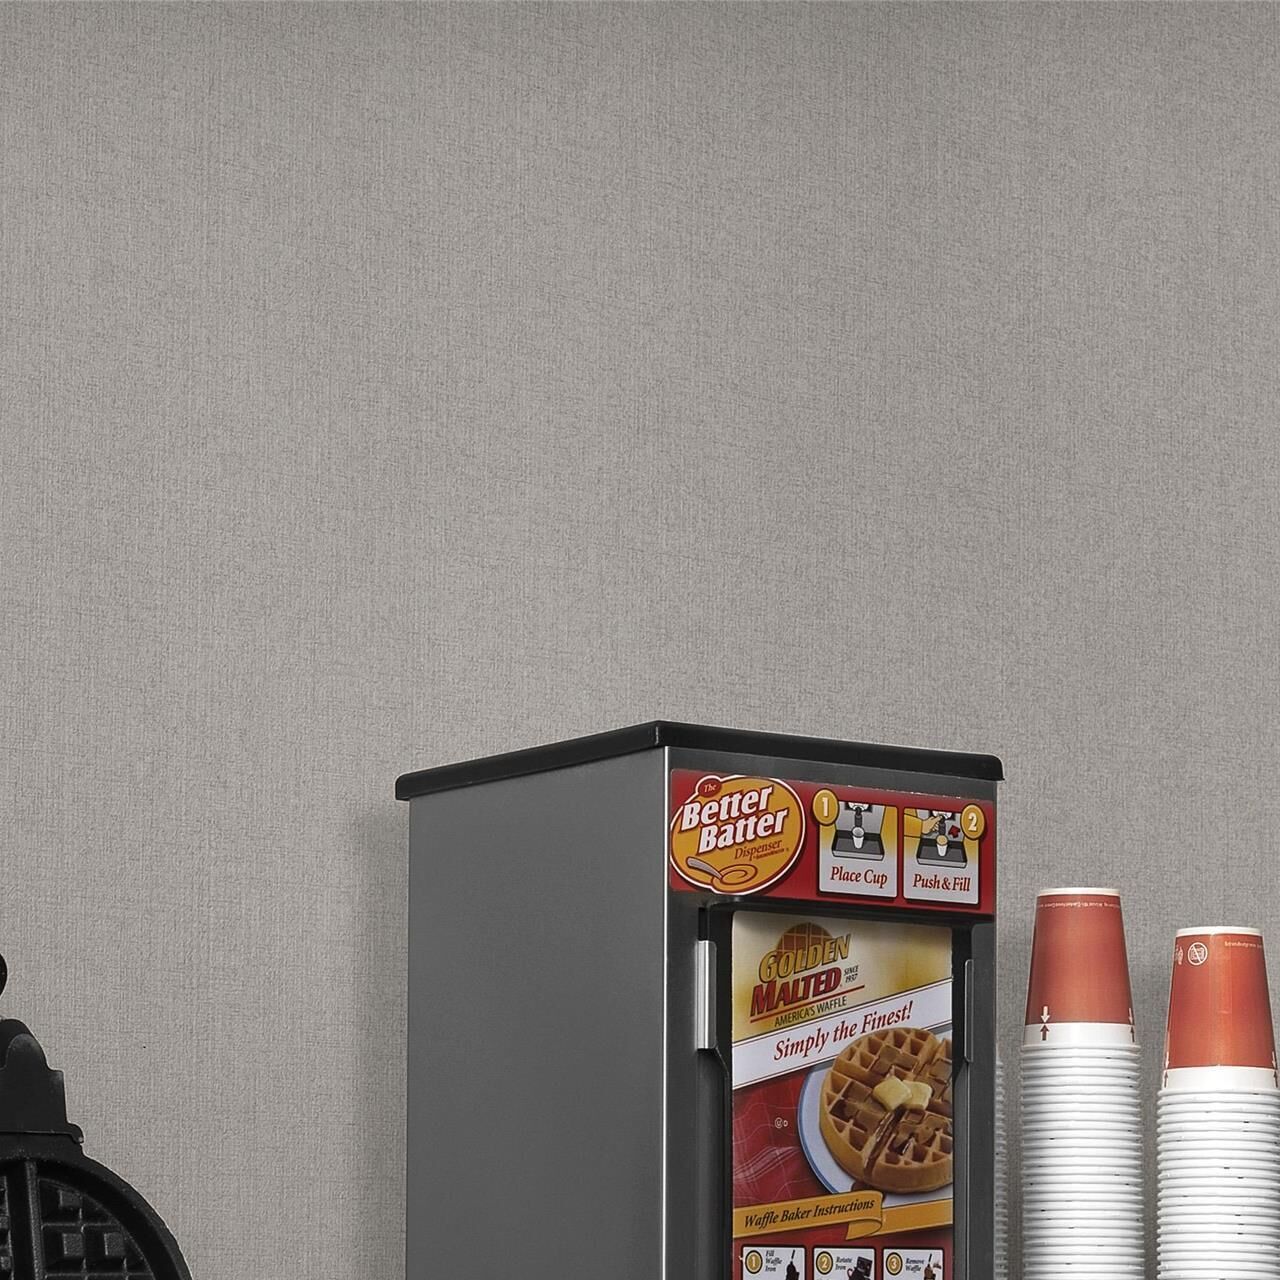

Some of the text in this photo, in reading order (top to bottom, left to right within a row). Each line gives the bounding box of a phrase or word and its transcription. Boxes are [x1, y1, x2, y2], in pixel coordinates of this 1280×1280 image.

[704, 784, 716, 792] The
[681, 786, 773, 831] Better
[822, 797, 828, 817] 1
[968, 813, 978, 832] 2
[698, 809, 788, 854] Batter
[734, 840, 782, 861] Dispenser
[830, 866, 888, 889] Place Cup
[912, 873, 971, 892] Push & Fill
[759, 933, 851, 984] GOLDEN
[750, 966, 842, 1017] MALTED
[774, 995, 847, 1027] AMERICA'S WAFFLE
[773, 1000, 914, 1061] Simply the Finest!
[744, 1198, 875, 1230] Waffle Baker Instructions
